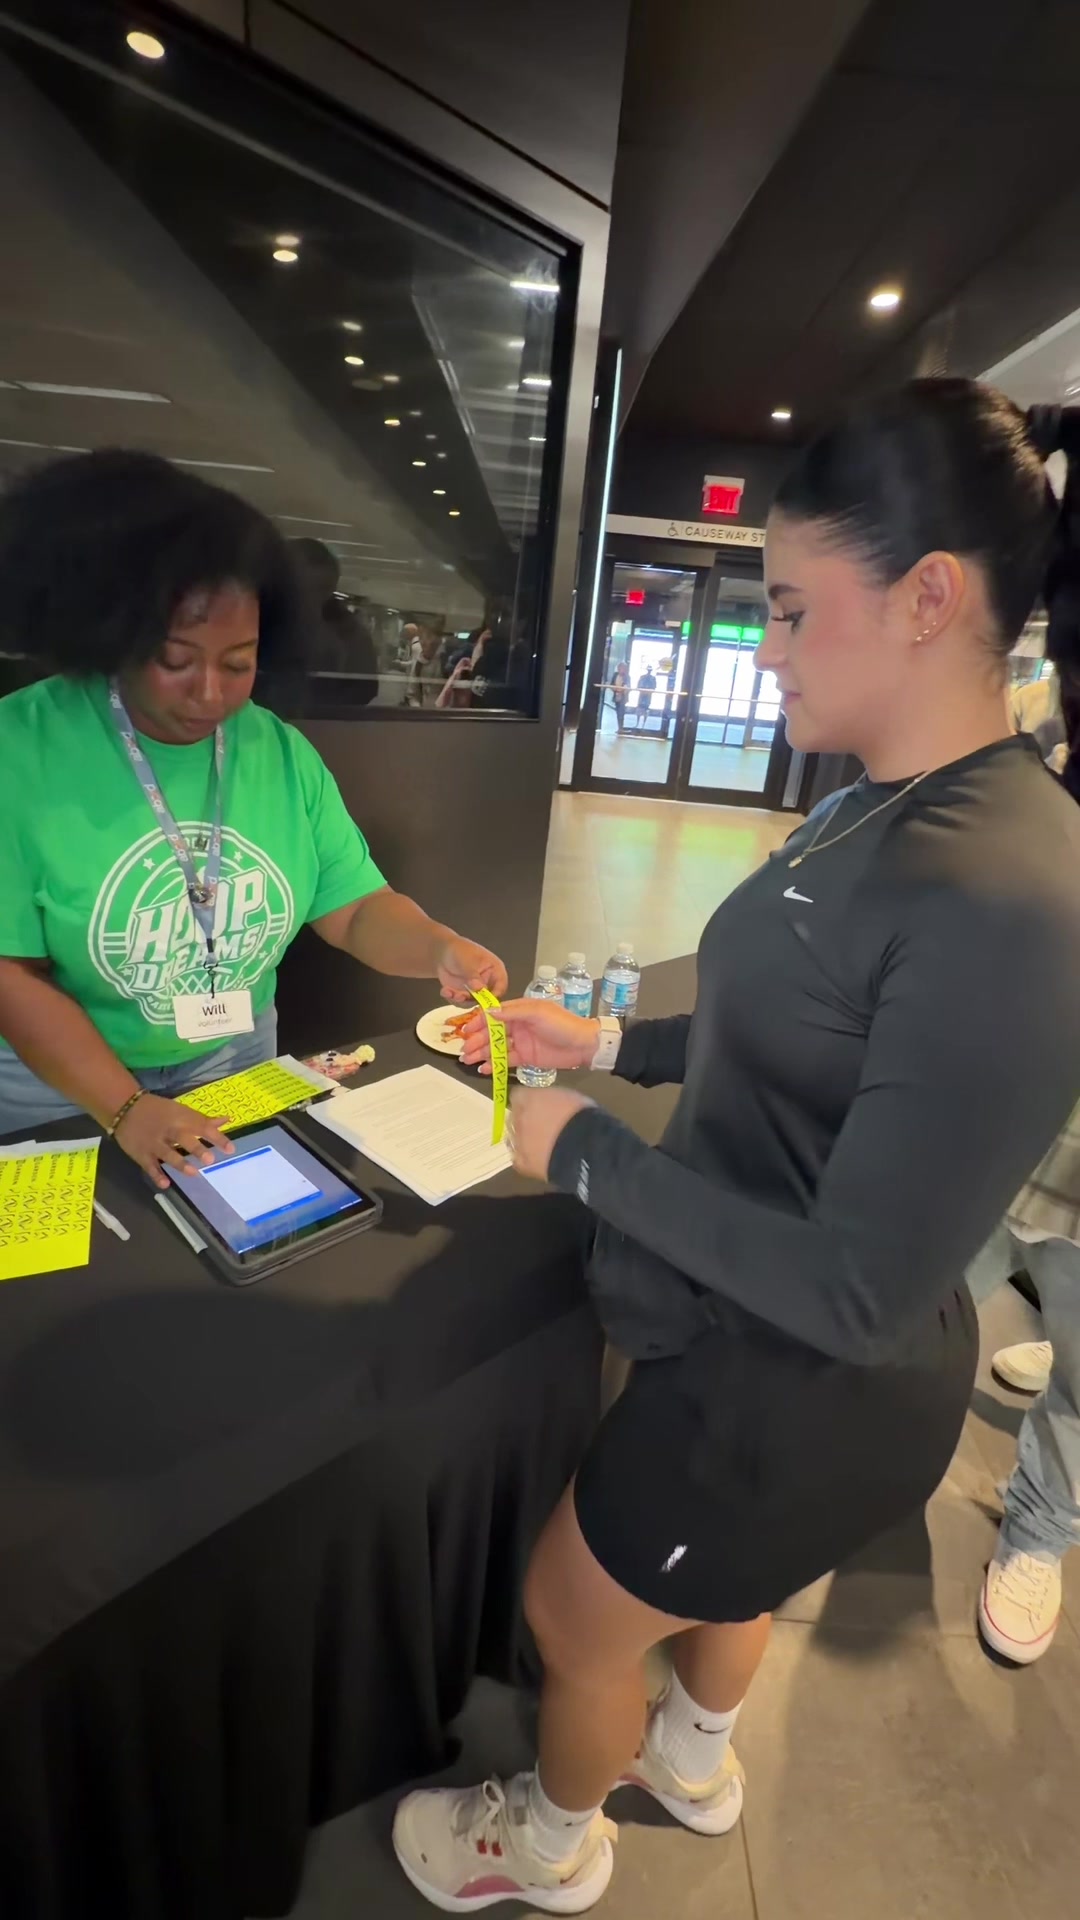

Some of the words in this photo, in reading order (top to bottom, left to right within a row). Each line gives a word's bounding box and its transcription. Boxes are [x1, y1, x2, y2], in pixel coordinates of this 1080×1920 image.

[685, 526, 748, 541] CAUSEWAY
[751, 532, 766, 543] ST
[128, 868, 265, 963] HOOP
[132, 925, 260, 991] DREAMS
[202, 1003, 227, 1017] Will
